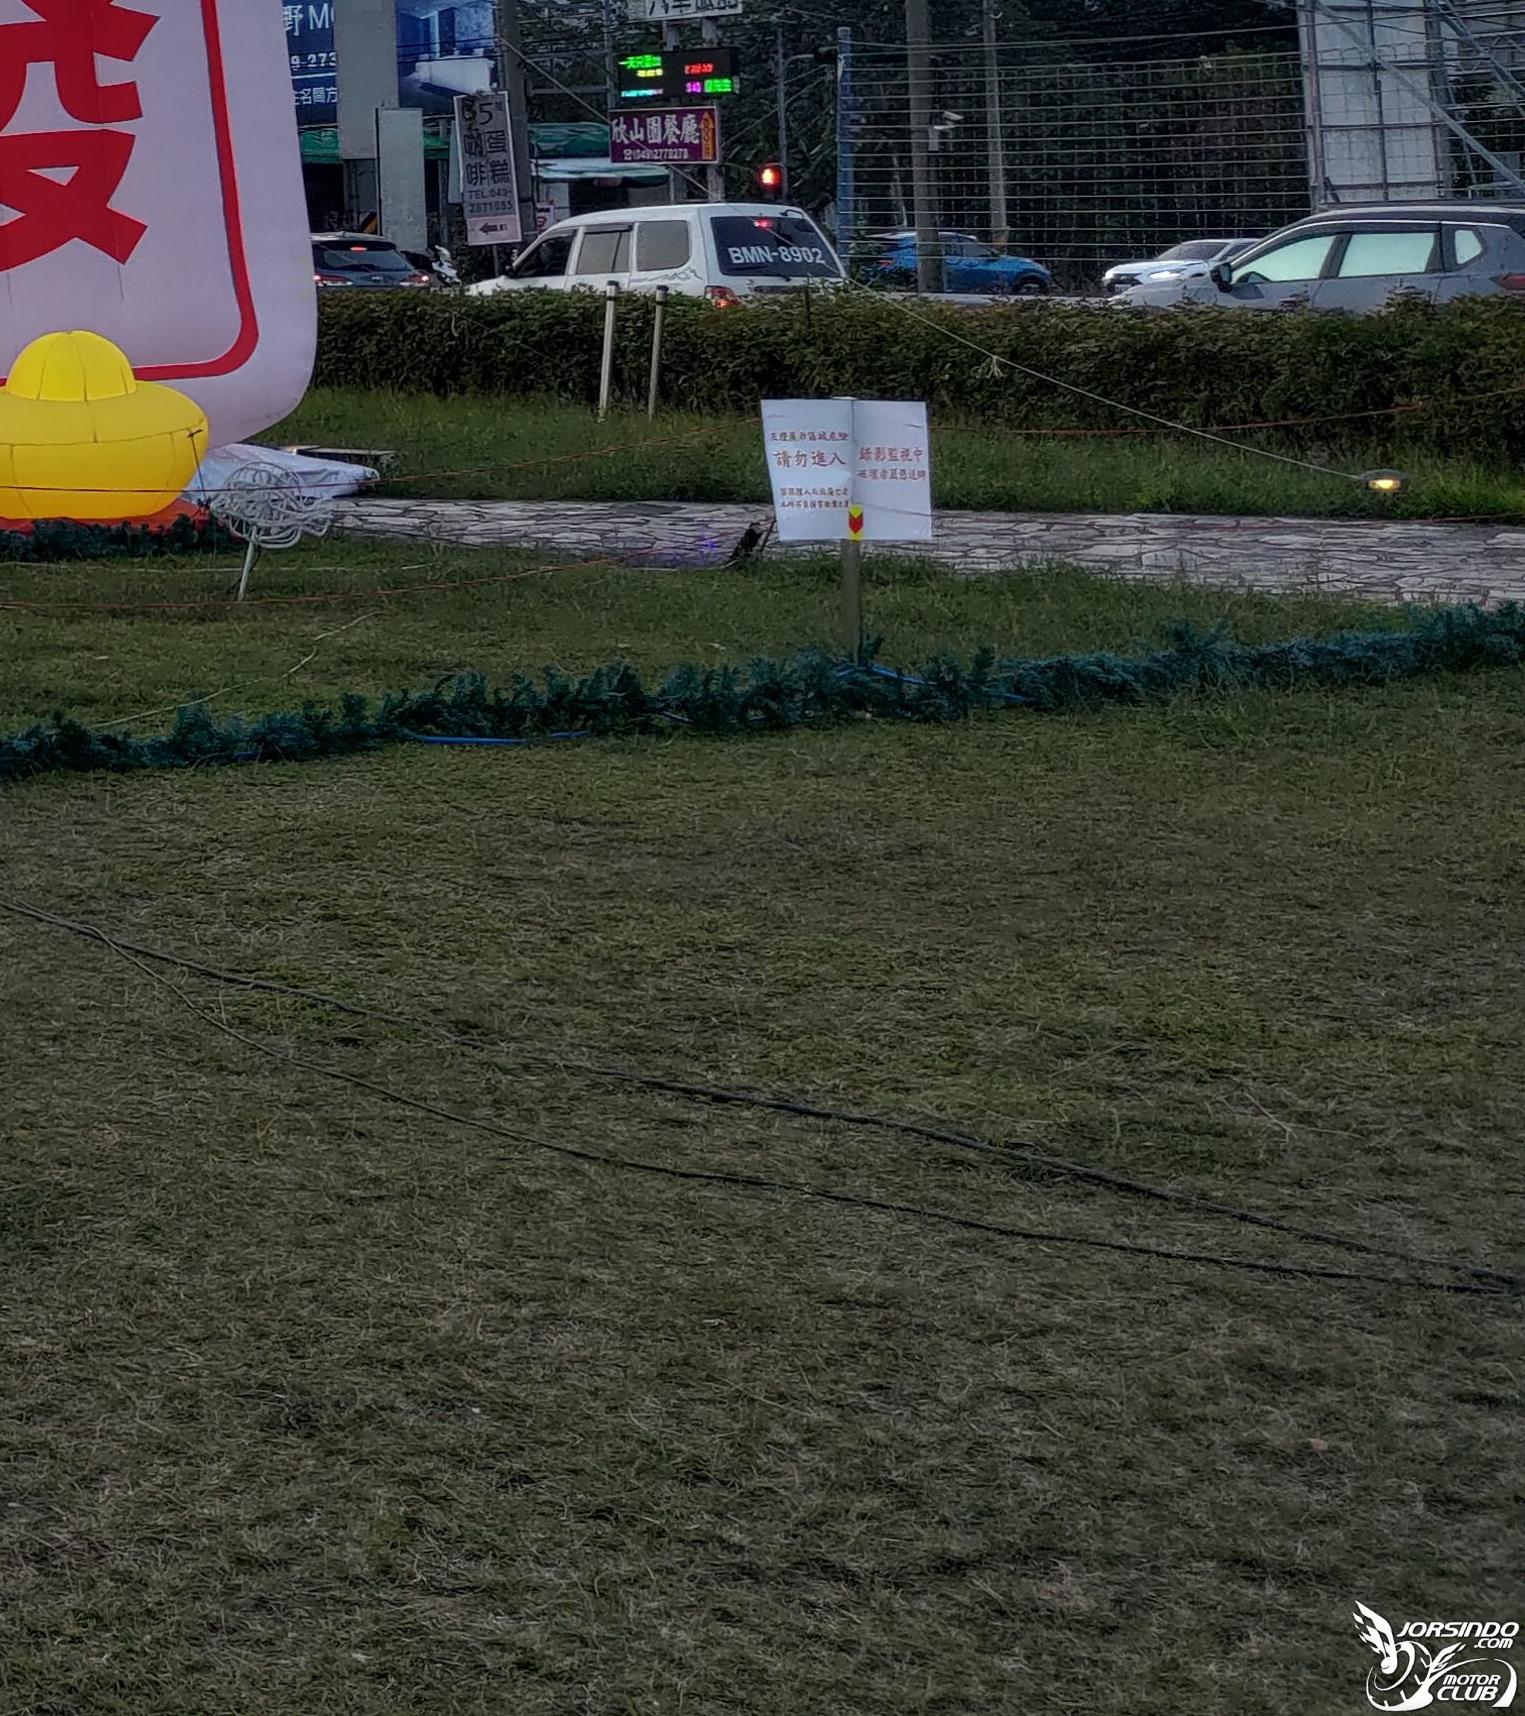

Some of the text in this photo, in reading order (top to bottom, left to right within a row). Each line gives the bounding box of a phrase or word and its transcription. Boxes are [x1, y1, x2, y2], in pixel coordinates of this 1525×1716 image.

[309, 2, 335, 31] M
[727, 246, 826, 264] BMN-8902
[774, 449, 848, 468] 請勿進入
